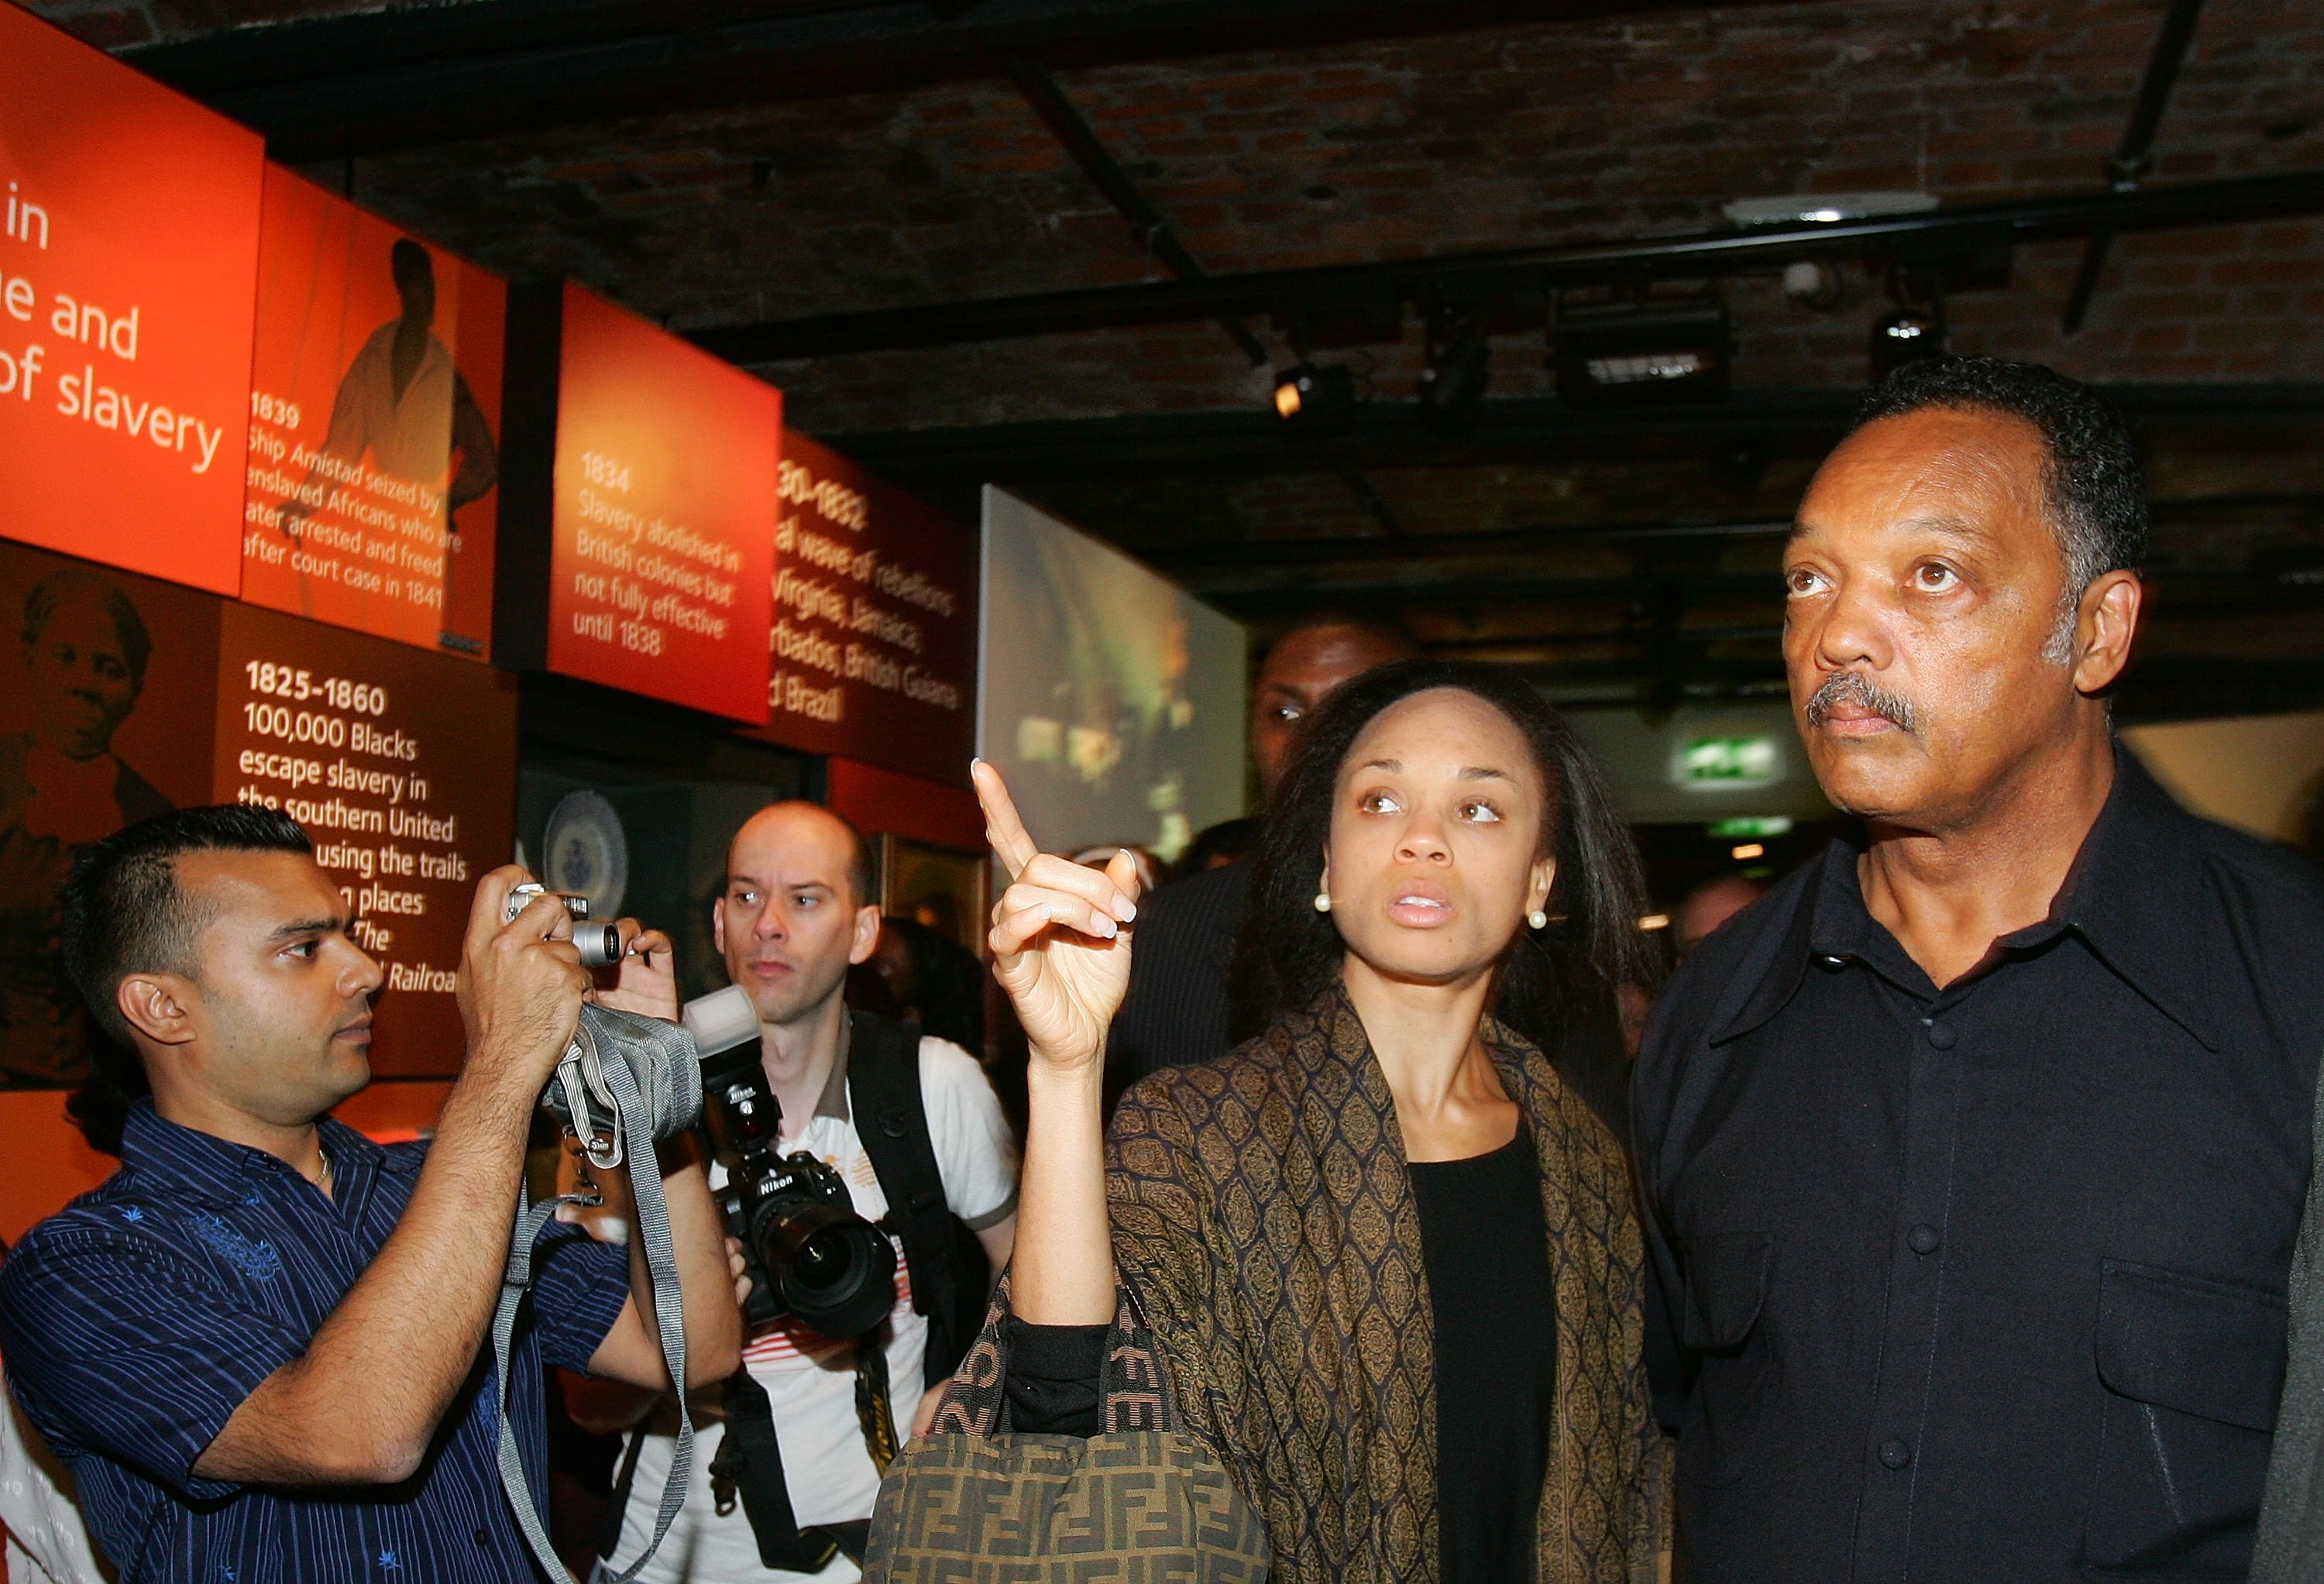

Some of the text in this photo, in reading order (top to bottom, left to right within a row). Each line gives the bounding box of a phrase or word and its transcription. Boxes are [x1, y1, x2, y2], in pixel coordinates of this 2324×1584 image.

[7, 182, 50, 249] in
[0, 271, 139, 361] e and
[0, 345, 223, 474] of slavery
[251, 391, 301, 430] 1839
[289, 442, 364, 487] Amistad
[366, 472, 417, 506] seized
[420, 488, 442, 518] by
[581, 452, 631, 494] 1834
[246, 502, 444, 579] ater arrested and freed
[327, 491, 397, 533] Africans
[400, 517, 435, 544] who
[438, 532, 463, 553] are
[578, 488, 741, 575] Slavery abolished in
[290, 550, 339, 582] court
[343, 565, 382, 593] case
[385, 574, 401, 599] in
[405, 582, 444, 610] 1841
[576, 528, 734, 608] British colonies but
[798, 531, 852, 576] wave
[852, 548, 879, 582] of
[572, 611, 662, 658] until 1838
[574, 572, 726, 641] not fully effective
[245, 659, 386, 716] 1825-1860
[786, 675, 844, 723] Brazil
[243, 702, 418, 761] 100,000 Blacks
[239, 748, 427, 805] escape slavery in
[284, 797, 383, 833] southern
[389, 808, 454, 844] United
[315, 839, 466, 883] using the trails
[358, 880, 424, 919] places
[353, 919, 390, 952] The
[388, 960, 458, 993] Railroa
[760, 1174, 793, 1196] Nikon
